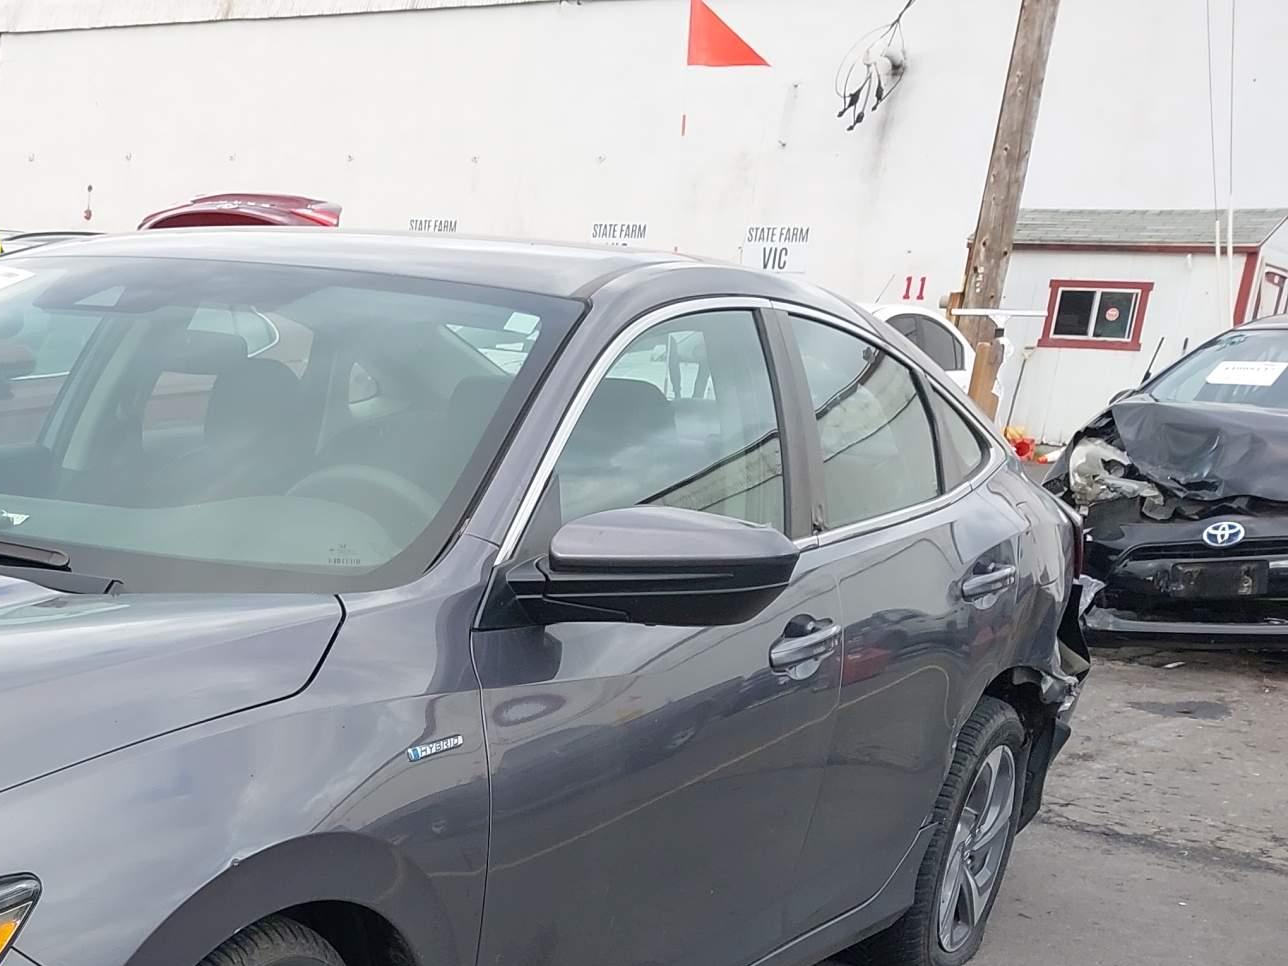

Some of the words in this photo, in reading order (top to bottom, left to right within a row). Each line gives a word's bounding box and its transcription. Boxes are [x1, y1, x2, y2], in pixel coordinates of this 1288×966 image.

[409, 219, 432, 232] STATE
[433, 220, 457, 233] FARM
[592, 223, 618, 239] STATE
[619, 224, 646, 240] FARM
[747, 227, 776, 243] STATE
[778, 228, 809, 243] FARM
[762, 247, 788, 270] VIC
[902, 276, 927, 300] 11
